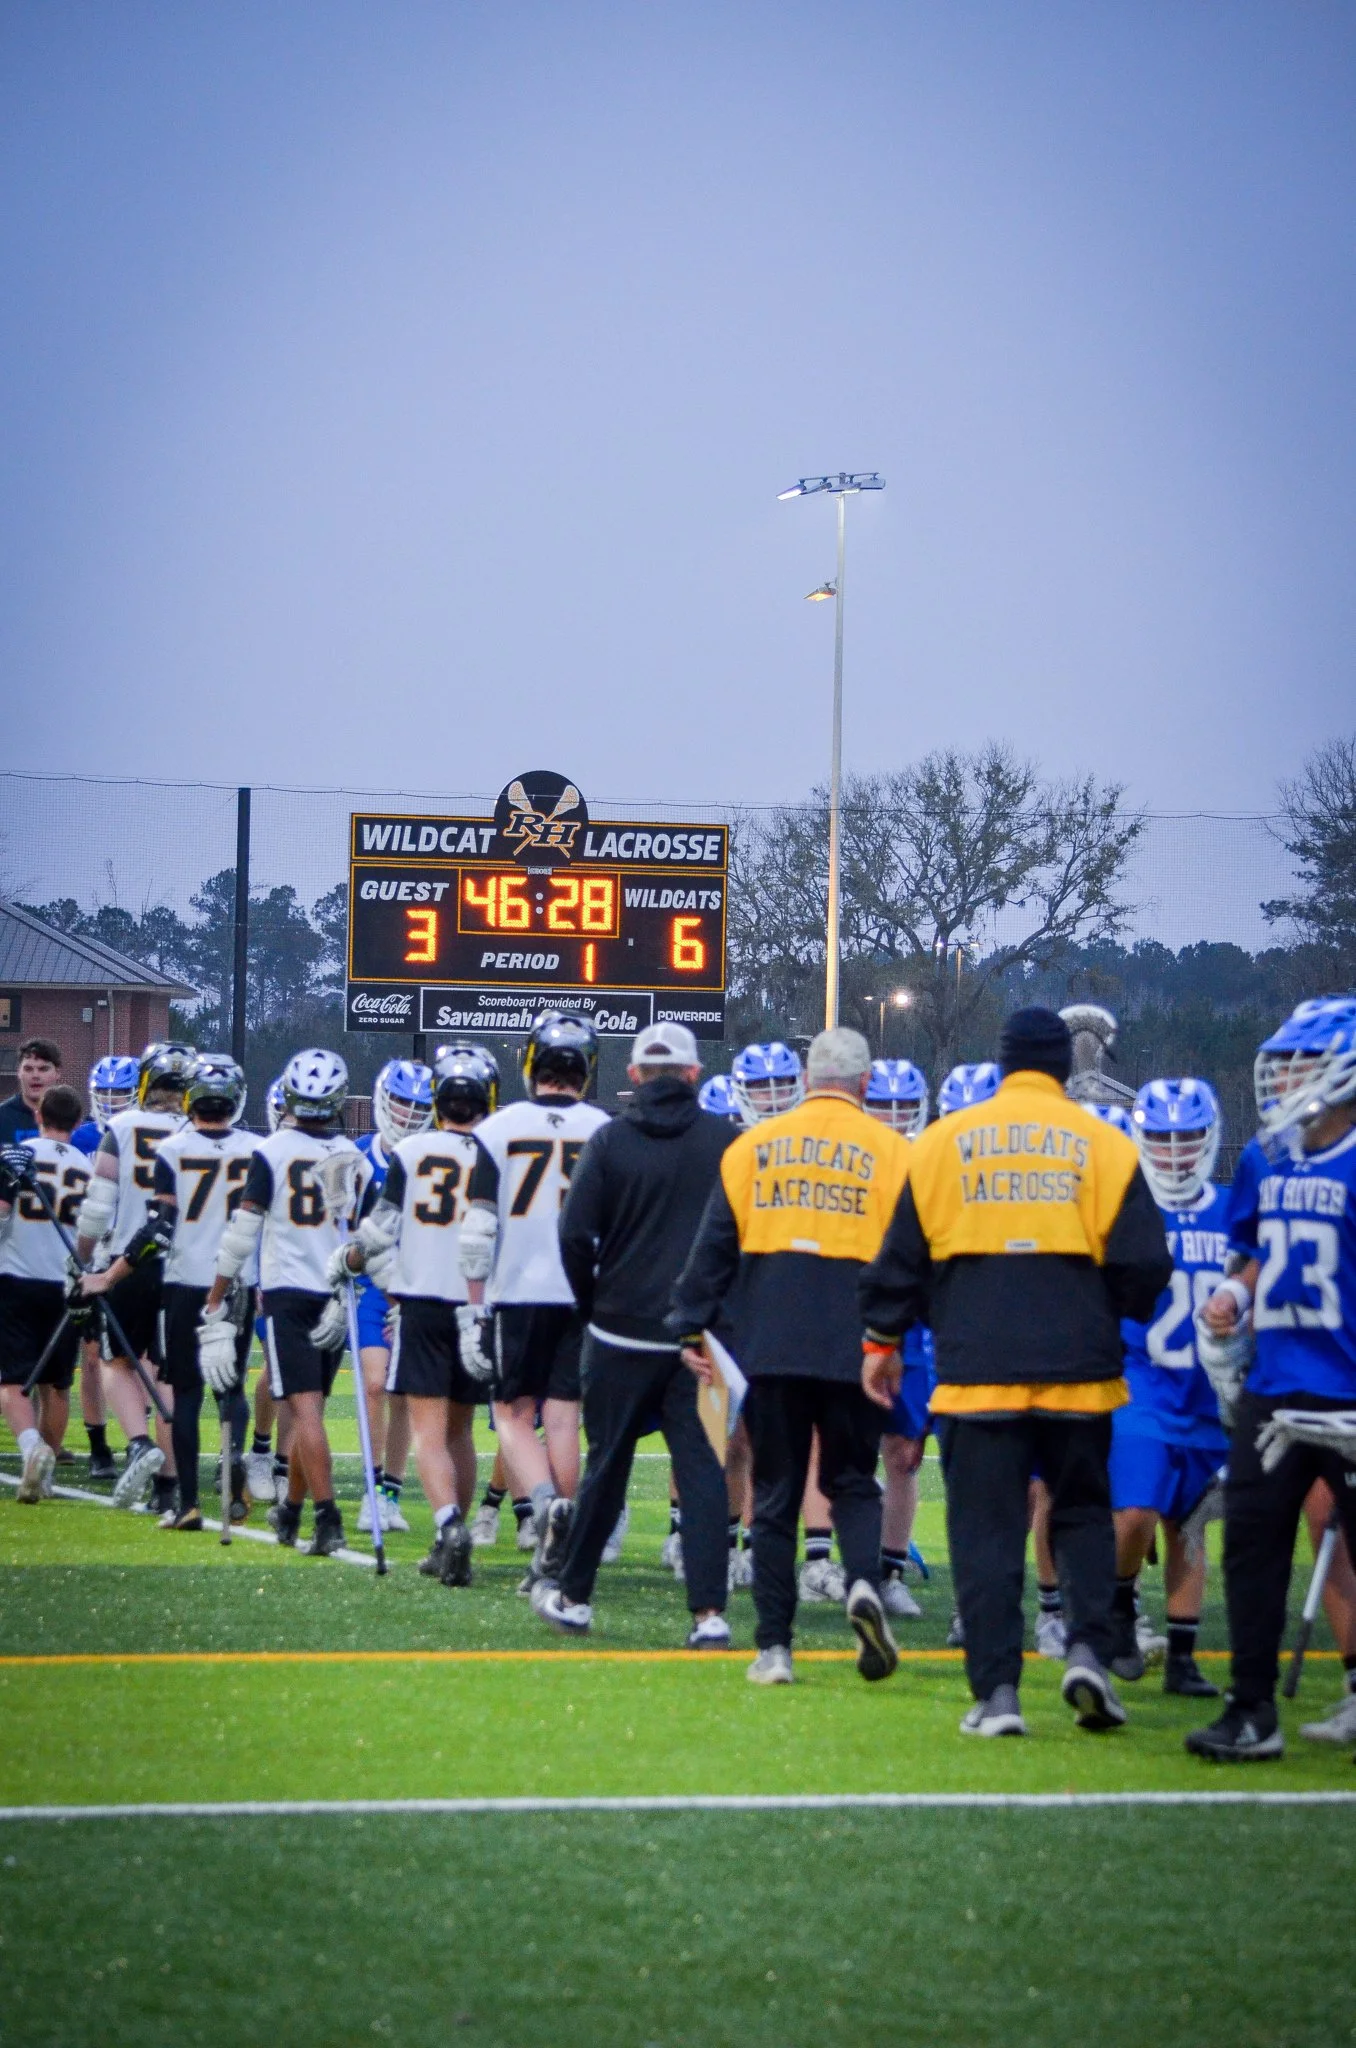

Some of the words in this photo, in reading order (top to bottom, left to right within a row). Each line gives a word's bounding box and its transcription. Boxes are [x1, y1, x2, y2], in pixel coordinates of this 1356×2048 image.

[363, 824, 497, 854] WILDCAT
[583, 831, 721, 861] LACROSSE
[503, 809, 581, 847] RH
[360, 880, 449, 901] GUEST
[465, 876, 613, 929] 46:28
[624, 888, 722, 910] WILDCATS
[404, 909, 437, 962] 3
[672, 917, 704, 969] 6
[480, 952, 559, 970] PERIOD
[584, 943, 594, 982] 1
[351, 992, 414, 1015] Coca-Cola
[436, 1006, 533, 1028] Savannah
[478, 995, 536, 1007] Scoreboard
[538, 997, 581, 1008] Provided
[583, 998, 597, 1010] By
[657, 1010, 722, 1022] POWERADE
[755, 1136, 874, 1180] WILDCATS
[957, 1123, 1089, 1167] WILDCATS
[415, 1155, 476, 1226] 3
[754, 1178, 869, 1215] LACROSSE
[961, 1171, 1082, 1204] LACROSS
[1253, 1218, 1342, 1330] 23
